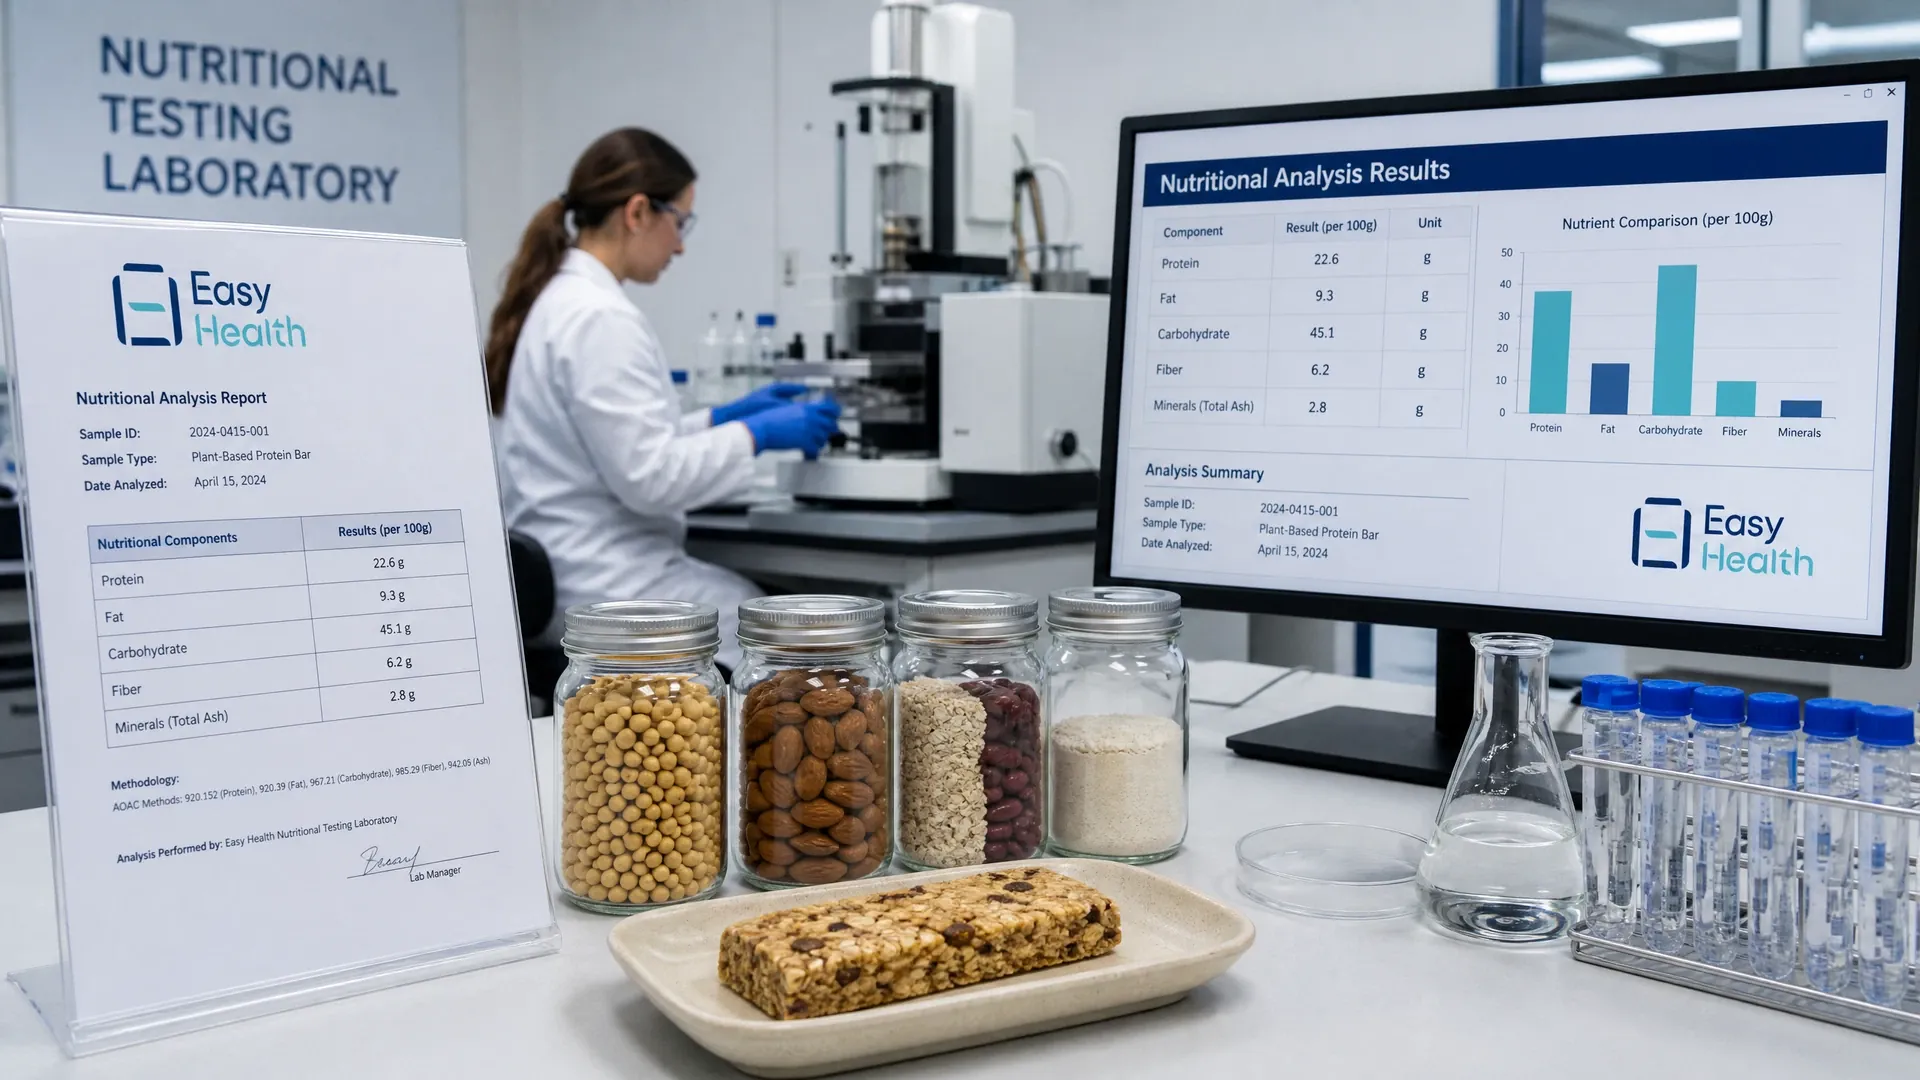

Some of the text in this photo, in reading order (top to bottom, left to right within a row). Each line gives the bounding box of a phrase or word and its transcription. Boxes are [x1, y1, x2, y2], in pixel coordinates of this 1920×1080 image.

[100, 36, 398, 97] NUTRITIONAL
[100, 94, 293, 143] TESTING
[103, 152, 399, 204] LABORATORY
[1160, 159, 1450, 195] Nutritional Analysis Results
[1286, 218, 1378, 235] Result (per 100g)
[1418, 216, 1443, 229] Unit
[1562, 210, 1774, 231] Nutrient Comparison (per 100g)
[1163, 225, 1224, 240] Component
[1314, 252, 1340, 266] 22.6
[1423, 252, 1432, 266] g
[1500, 247, 1514, 258] 50
[1161, 257, 1200, 270] Protein
[1499, 279, 1512, 289] 40
[191, 271, 271, 314] Easy
[1159, 292, 1177, 305] Fat
[1315, 289, 1334, 302] 9.3
[1421, 290, 1429, 303] g
[1497, 311, 1511, 321] 30
[195, 314, 306, 347] Health
[1157, 327, 1231, 343] Carbohydrate
[1309, 326, 1335, 339] 45.1
[1419, 328, 1428, 341] g
[1496, 343, 1509, 353] 20
[1156, 363, 1184, 376] Fiber
[1311, 363, 1330, 376] 6.2
[1417, 366, 1426, 379] g
[1495, 375, 1508, 385] 10
[76, 390, 268, 408] Nutritional Analysis Report
[1153, 399, 1255, 414] Minerals (Total Ash)
[1308, 401, 1327, 414] 2.8
[1415, 404, 1424, 418] g
[1499, 407, 1506, 418] 0
[79, 427, 141, 442] Sample ID:
[189, 425, 270, 438] 2024-0415-001
[1529, 422, 1563, 433] Protein
[1600, 423, 1616, 434] Fat
[1638, 424, 1703, 437] Carbohydrate
[1722, 425, 1748, 437] Fiber
[1778, 427, 1822, 438] Minerals
[81, 453, 157, 468] Sample Type:
[191, 448, 312, 463] Plant-Based Protein Bar
[1145, 463, 1264, 483] Analysis Summary
[83, 477, 168, 493] Date Analyzed:
[193, 474, 267, 490] April 15, 2024
[1143, 496, 1195, 511] Sample ID:
[1260, 502, 1339, 517] 2024-0415-001
[338, 521, 433, 538] Results (per 100g)
[1142, 516, 1207, 533] Sample Type:
[1703, 504, 1784, 544] Easy
[1259, 523, 1380, 541] Plant-Based Protein Bar
[97, 532, 238, 551] Nutritional Components
[1141, 536, 1213, 553] Date Analyzed:
[1257, 543, 1329, 559] April 15, 2024
[372, 556, 405, 570] 22.6 g
[1702, 542, 1814, 576] Health
[101, 572, 145, 587] Protein
[379, 589, 406, 603] 9.3 g
[104, 611, 125, 623] Fat
[379, 622, 412, 636] 45.1 g
[107, 643, 188, 661] Carbohydrate
[386, 656, 413, 669] 6.2 g
[111, 684, 142, 697] Fiber
[389, 689, 416, 703] 2.8 g
[115, 709, 229, 735] Minerals (Total Ash)
[110, 775, 180, 791] Methodology:
[112, 756, 491, 813] AOAC Methods: 920.152 (Protein), 920.39 (Fat), 967.21 (Carbohydrate), 985.29 (Fiber), 942.05 (Ash)
[116, 815, 398, 864] Analysis Performed by: Easy Health Nutritional Testing Laboratory
[408, 866, 462, 883] Lab Manager
